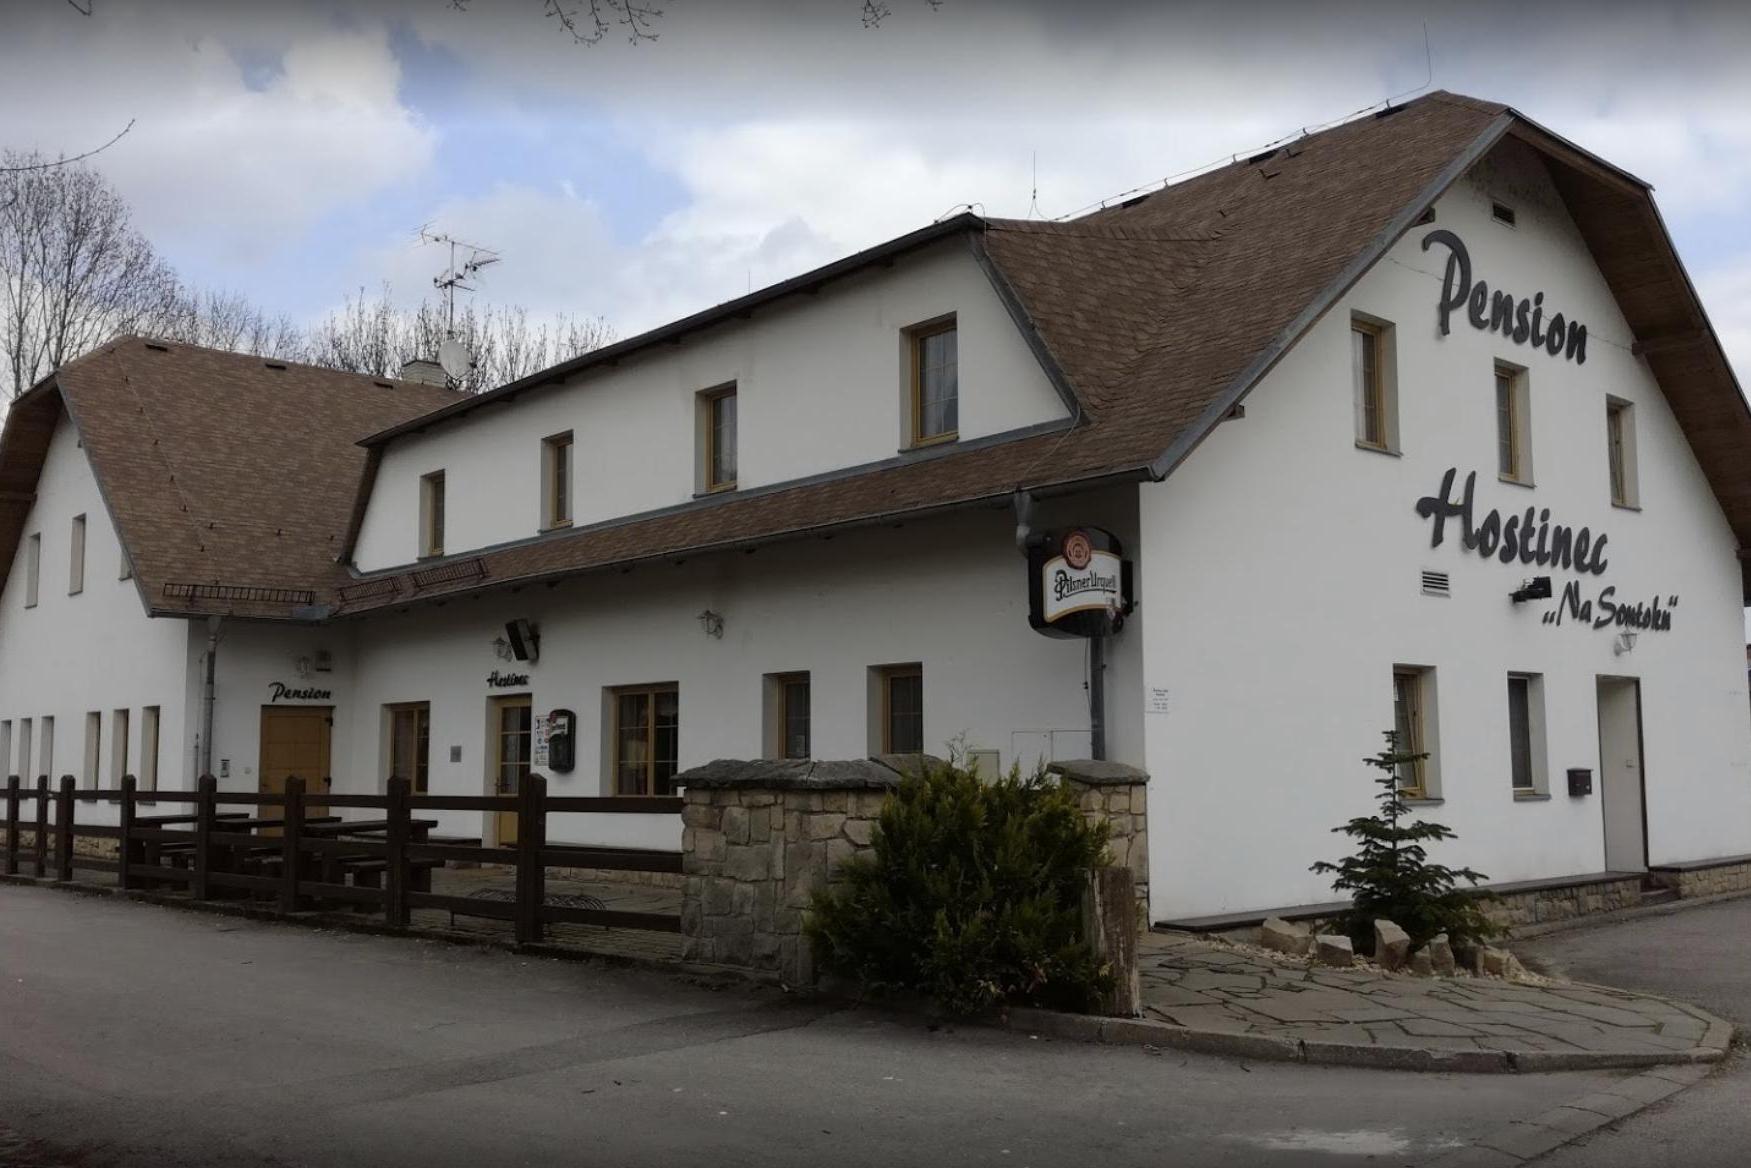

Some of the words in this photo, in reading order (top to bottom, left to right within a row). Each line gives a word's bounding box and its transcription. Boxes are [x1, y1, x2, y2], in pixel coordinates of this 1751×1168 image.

[1422, 230, 1587, 364] Pension
[1416, 467, 1607, 575] Hostinec
[1054, 569, 1090, 601] Pilsner
[1090, 570, 1117, 595] Urquell
[268, 682, 331, 702] Pension
